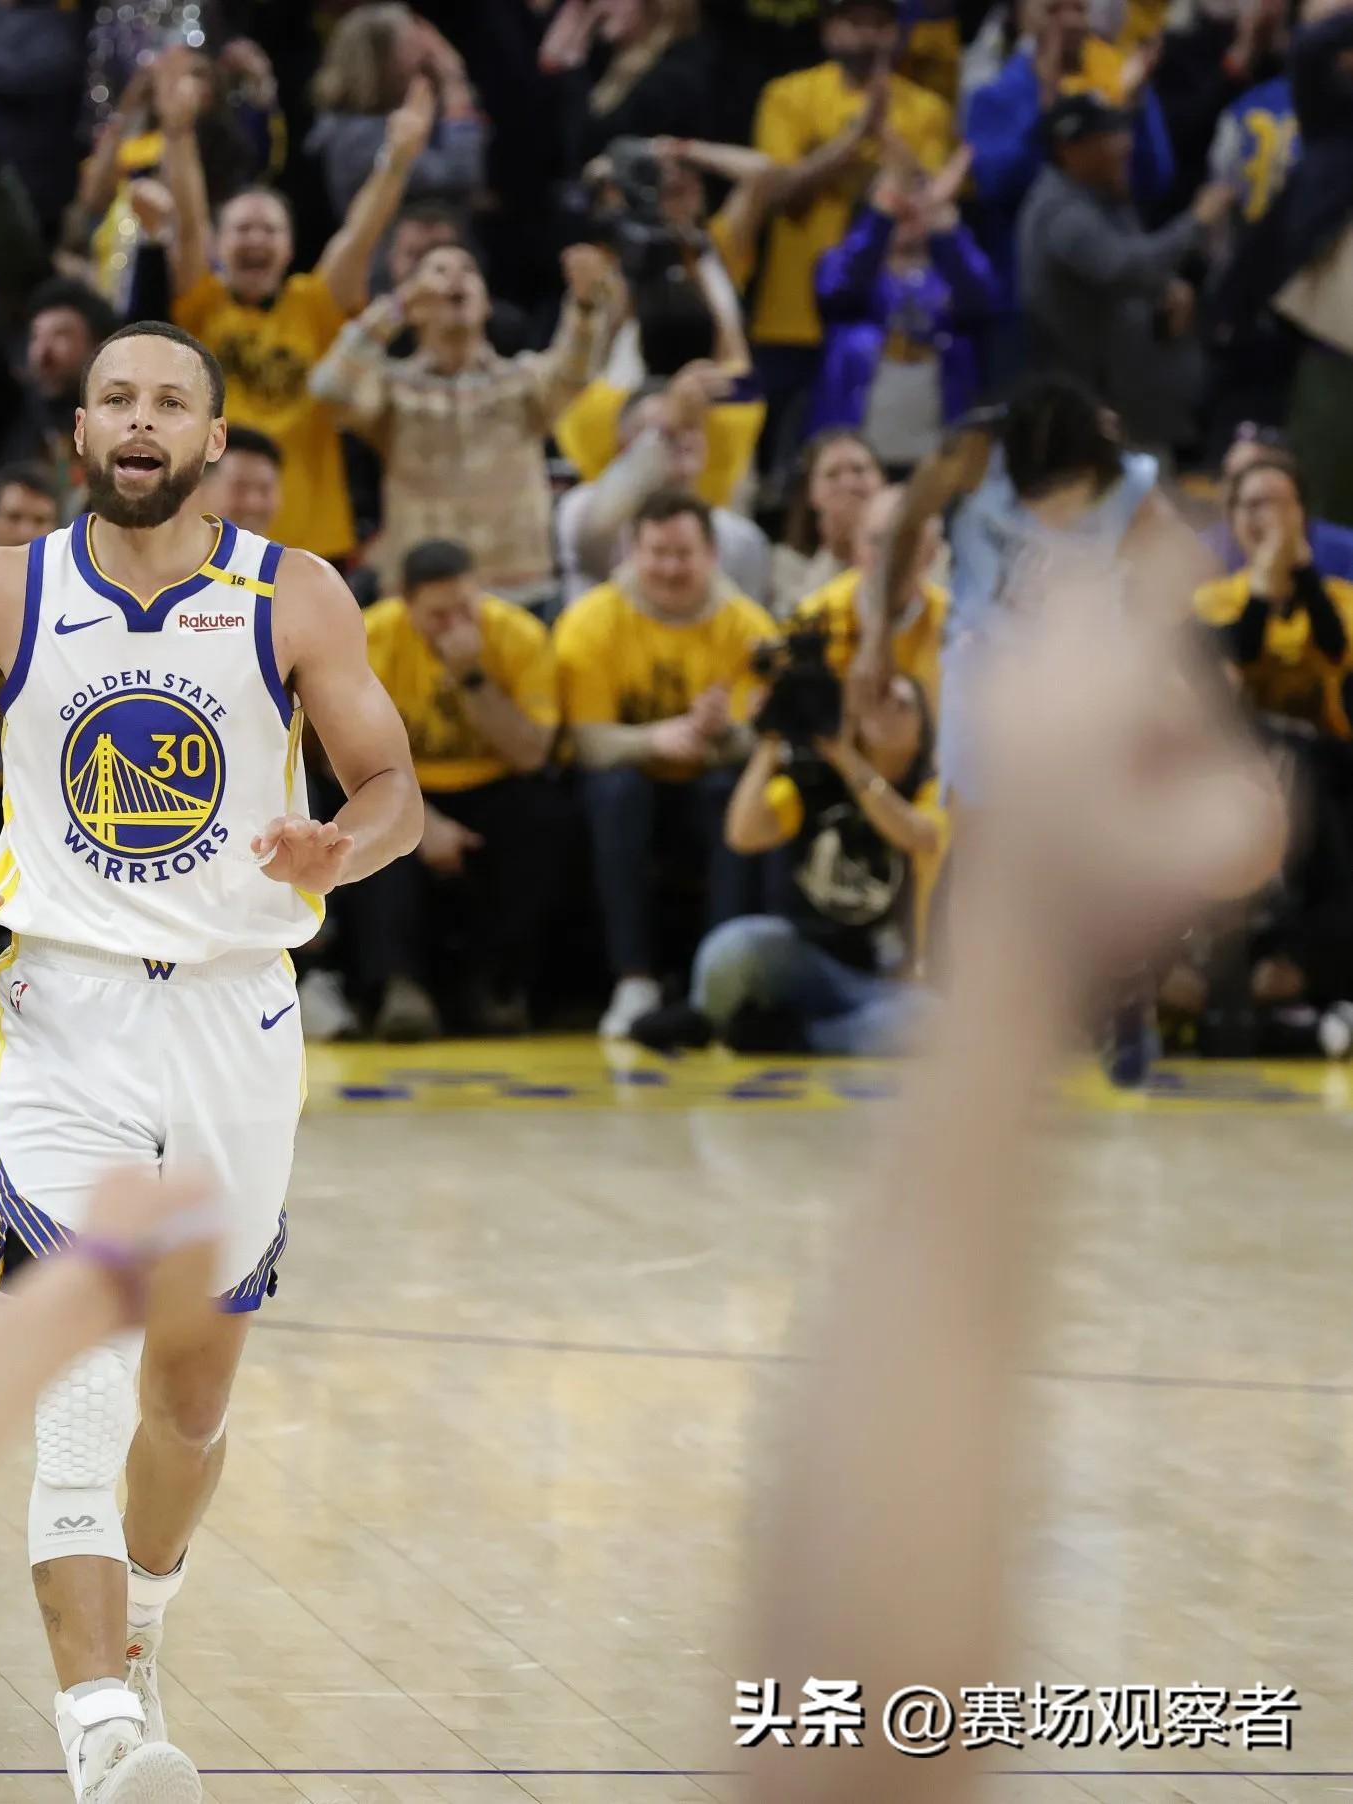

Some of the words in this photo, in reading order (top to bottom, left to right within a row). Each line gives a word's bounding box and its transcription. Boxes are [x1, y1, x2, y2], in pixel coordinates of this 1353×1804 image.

[179, 613, 245, 629] Rakuten
[60, 669, 151, 722] GOLDEN
[163, 673, 227, 723] STATE
[150, 734, 206, 779] 30
[63, 821, 230, 884] WARRIORS
[142, 957, 177, 981] W
